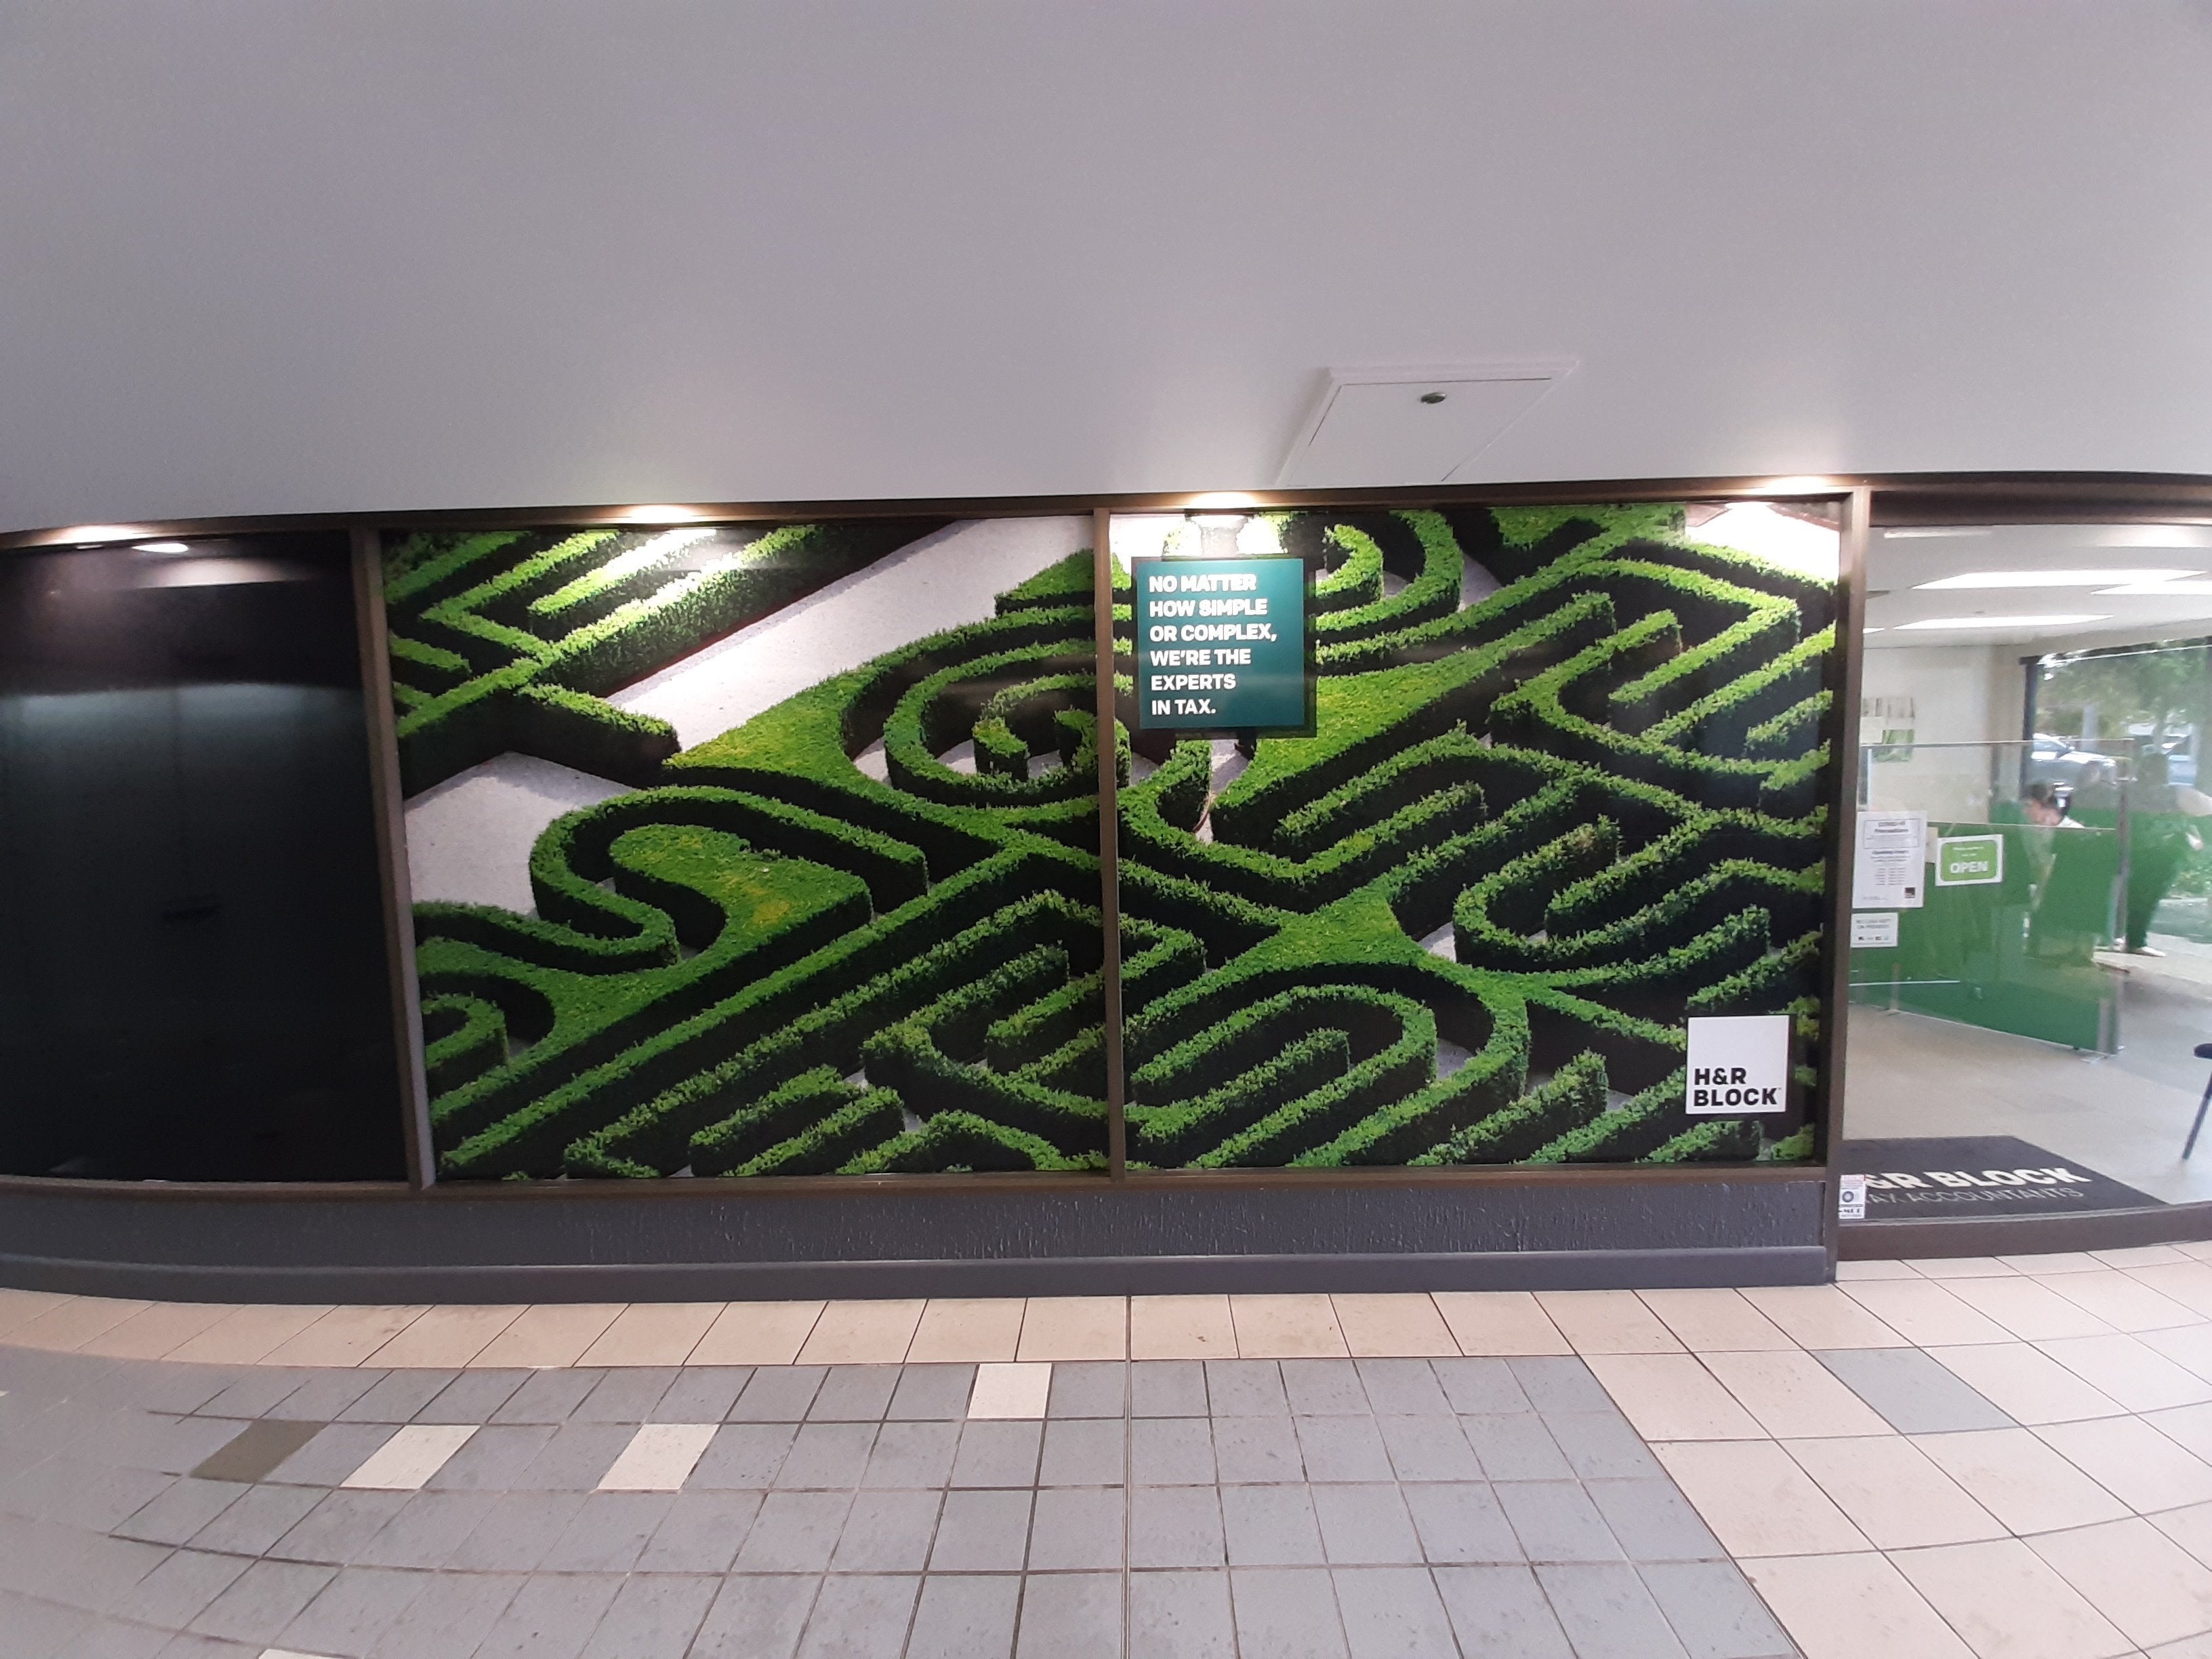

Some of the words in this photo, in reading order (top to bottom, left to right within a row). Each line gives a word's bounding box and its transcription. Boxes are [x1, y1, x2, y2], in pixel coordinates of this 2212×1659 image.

[1149, 575, 1177, 592] NO
[1181, 573, 1256, 592] MATTER
[1149, 600, 1195, 617] HOW
[1199, 598, 1268, 616] SIMPLE
[1149, 624, 1177, 642] OR
[1181, 623, 1277, 642] COMPLEX,
[1150, 649, 1210, 666] WE'RE
[1214, 649, 1251, 665] THE
[1151, 674, 1237, 691] EXPERTS
[1151, 699, 1170, 715] IN
[1174, 699, 1216, 714] TAX.
[1950, 861, 1988, 874] OPEN
[1694, 1067, 1746, 1085] H&R
[1694, 1088, 1777, 1107] BLOCK
[1864, 1172, 1934, 1189] &R
[1923, 1167, 2092, 1188] BLOCK
[1905, 1187, 2085, 1204] ACCOUNTANTS
